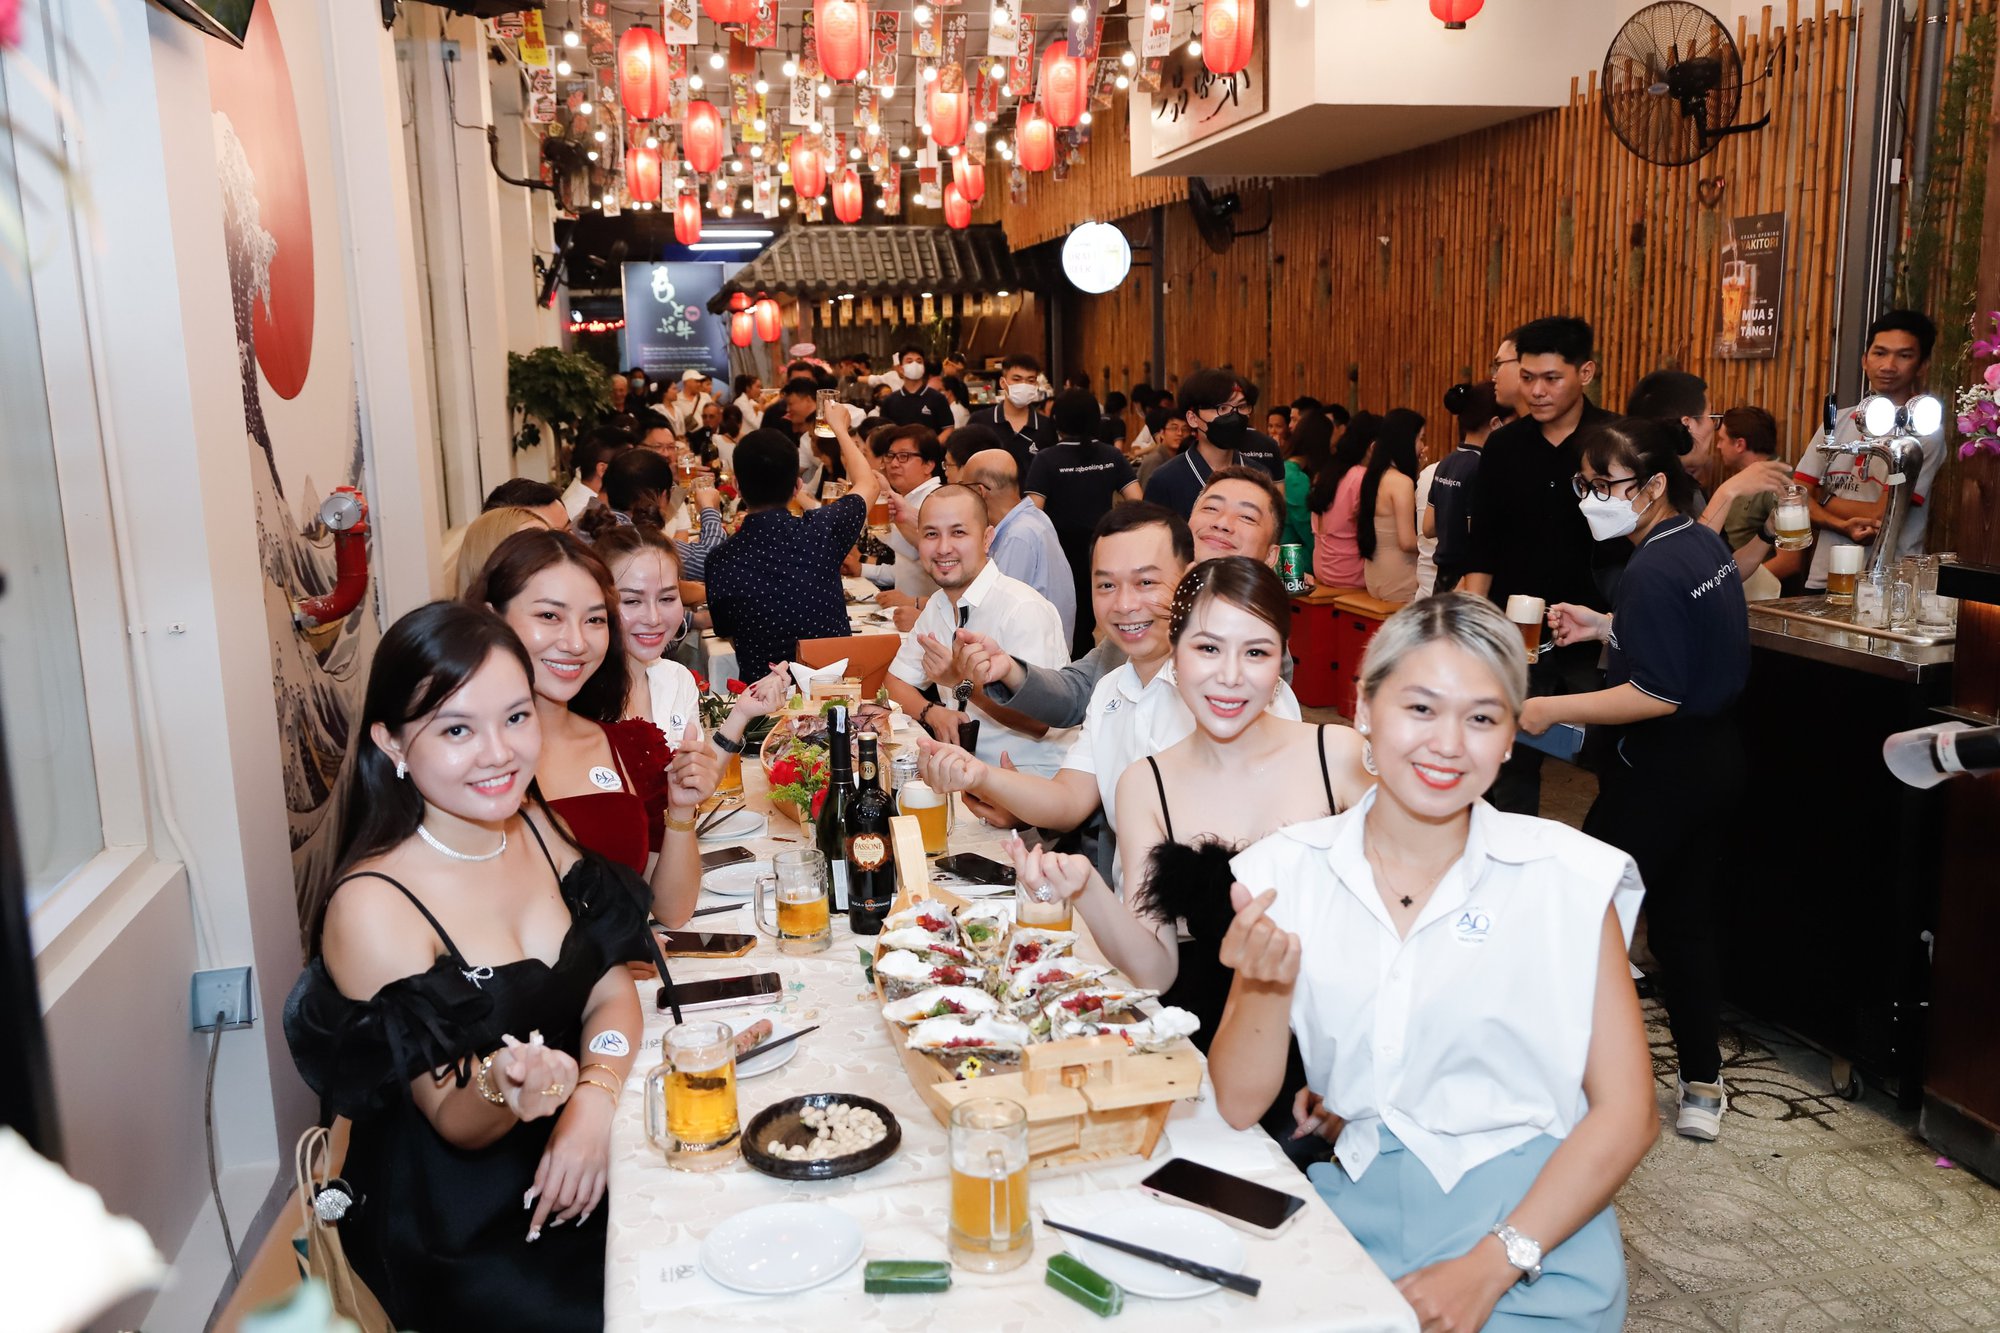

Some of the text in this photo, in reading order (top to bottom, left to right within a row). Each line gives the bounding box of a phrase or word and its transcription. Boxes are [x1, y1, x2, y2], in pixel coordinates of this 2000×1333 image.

[1741, 237, 1779, 250] YAKITORI
[1742, 308, 1774, 321] MUA 5
[1767, 325, 1773, 336] 1
